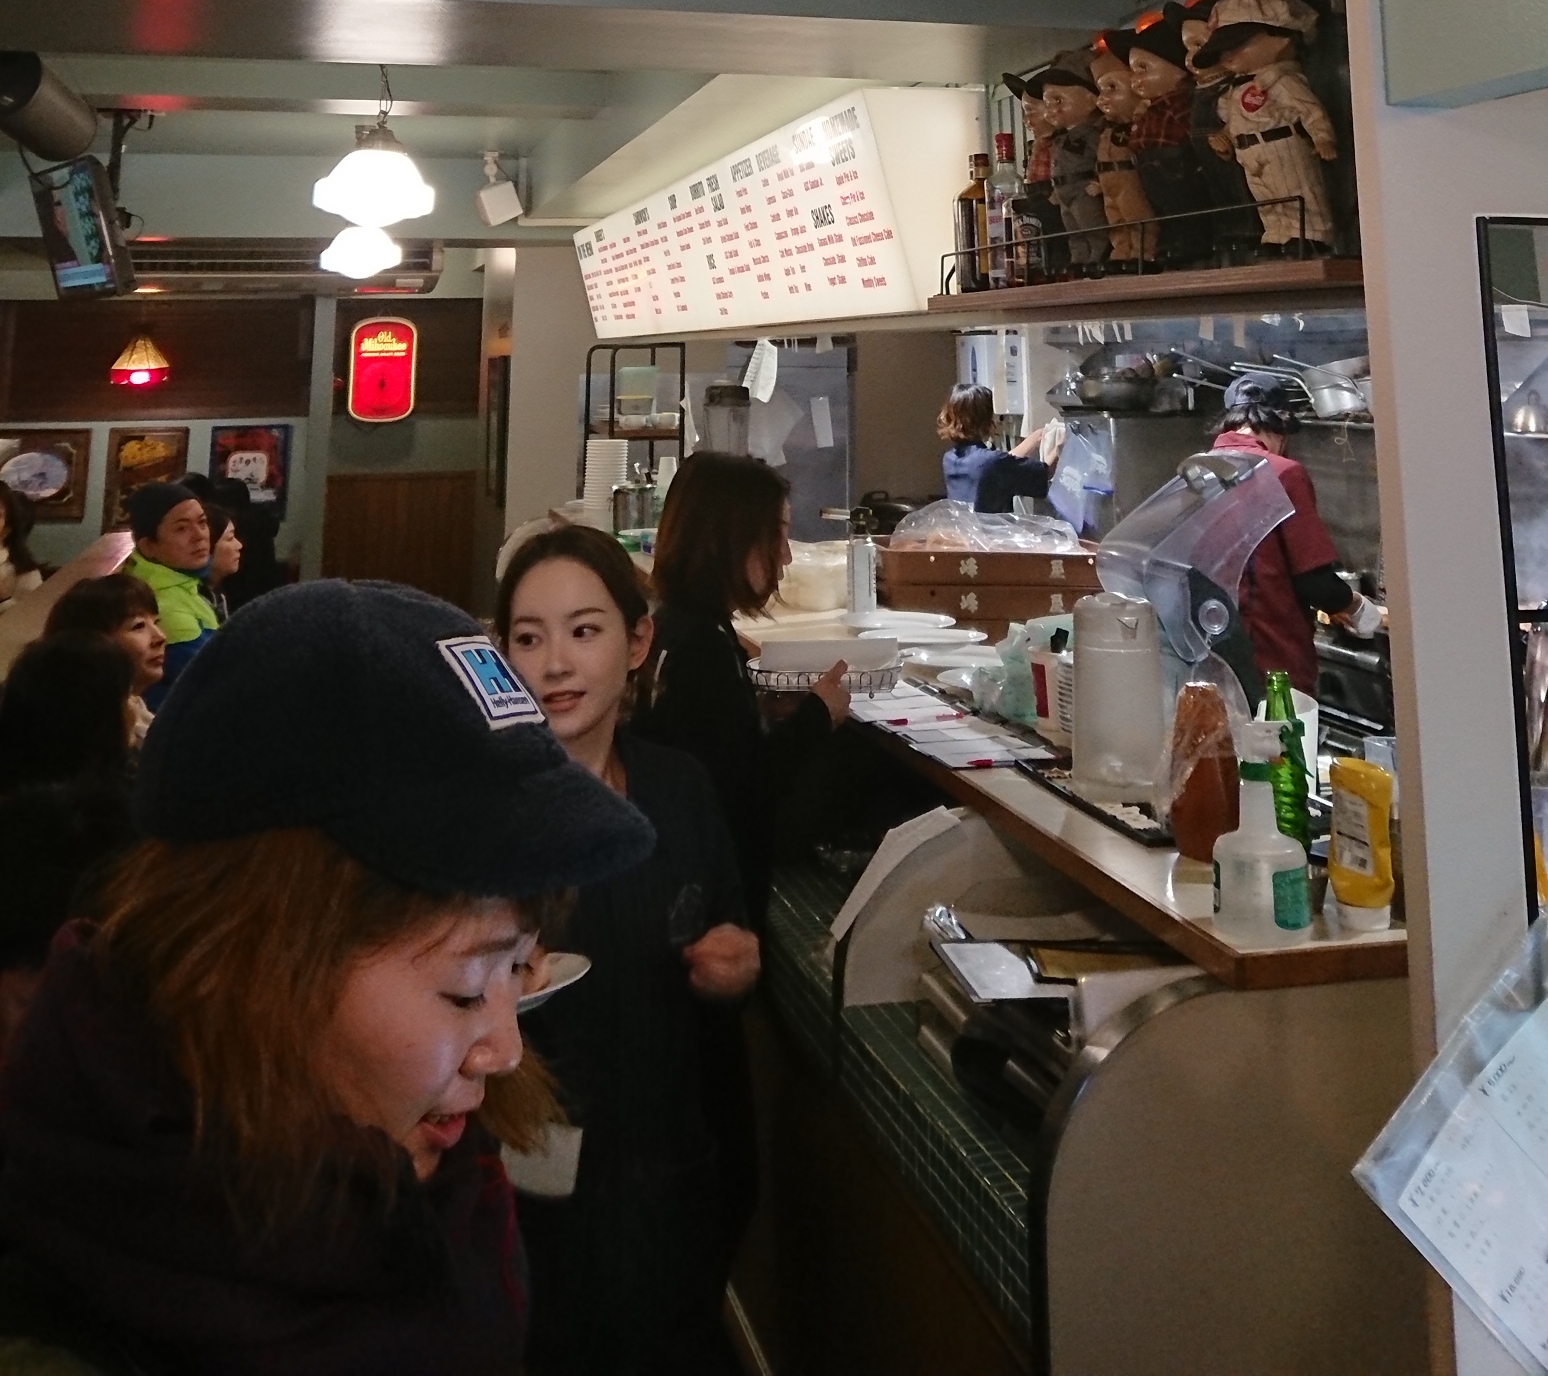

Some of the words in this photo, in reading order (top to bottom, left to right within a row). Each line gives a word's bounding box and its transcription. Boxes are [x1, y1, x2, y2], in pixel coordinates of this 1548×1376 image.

[811, 204, 835, 229] SHAKES
[378, 331, 392, 342] Old
[361, 338, 407, 351] Milwaukee
